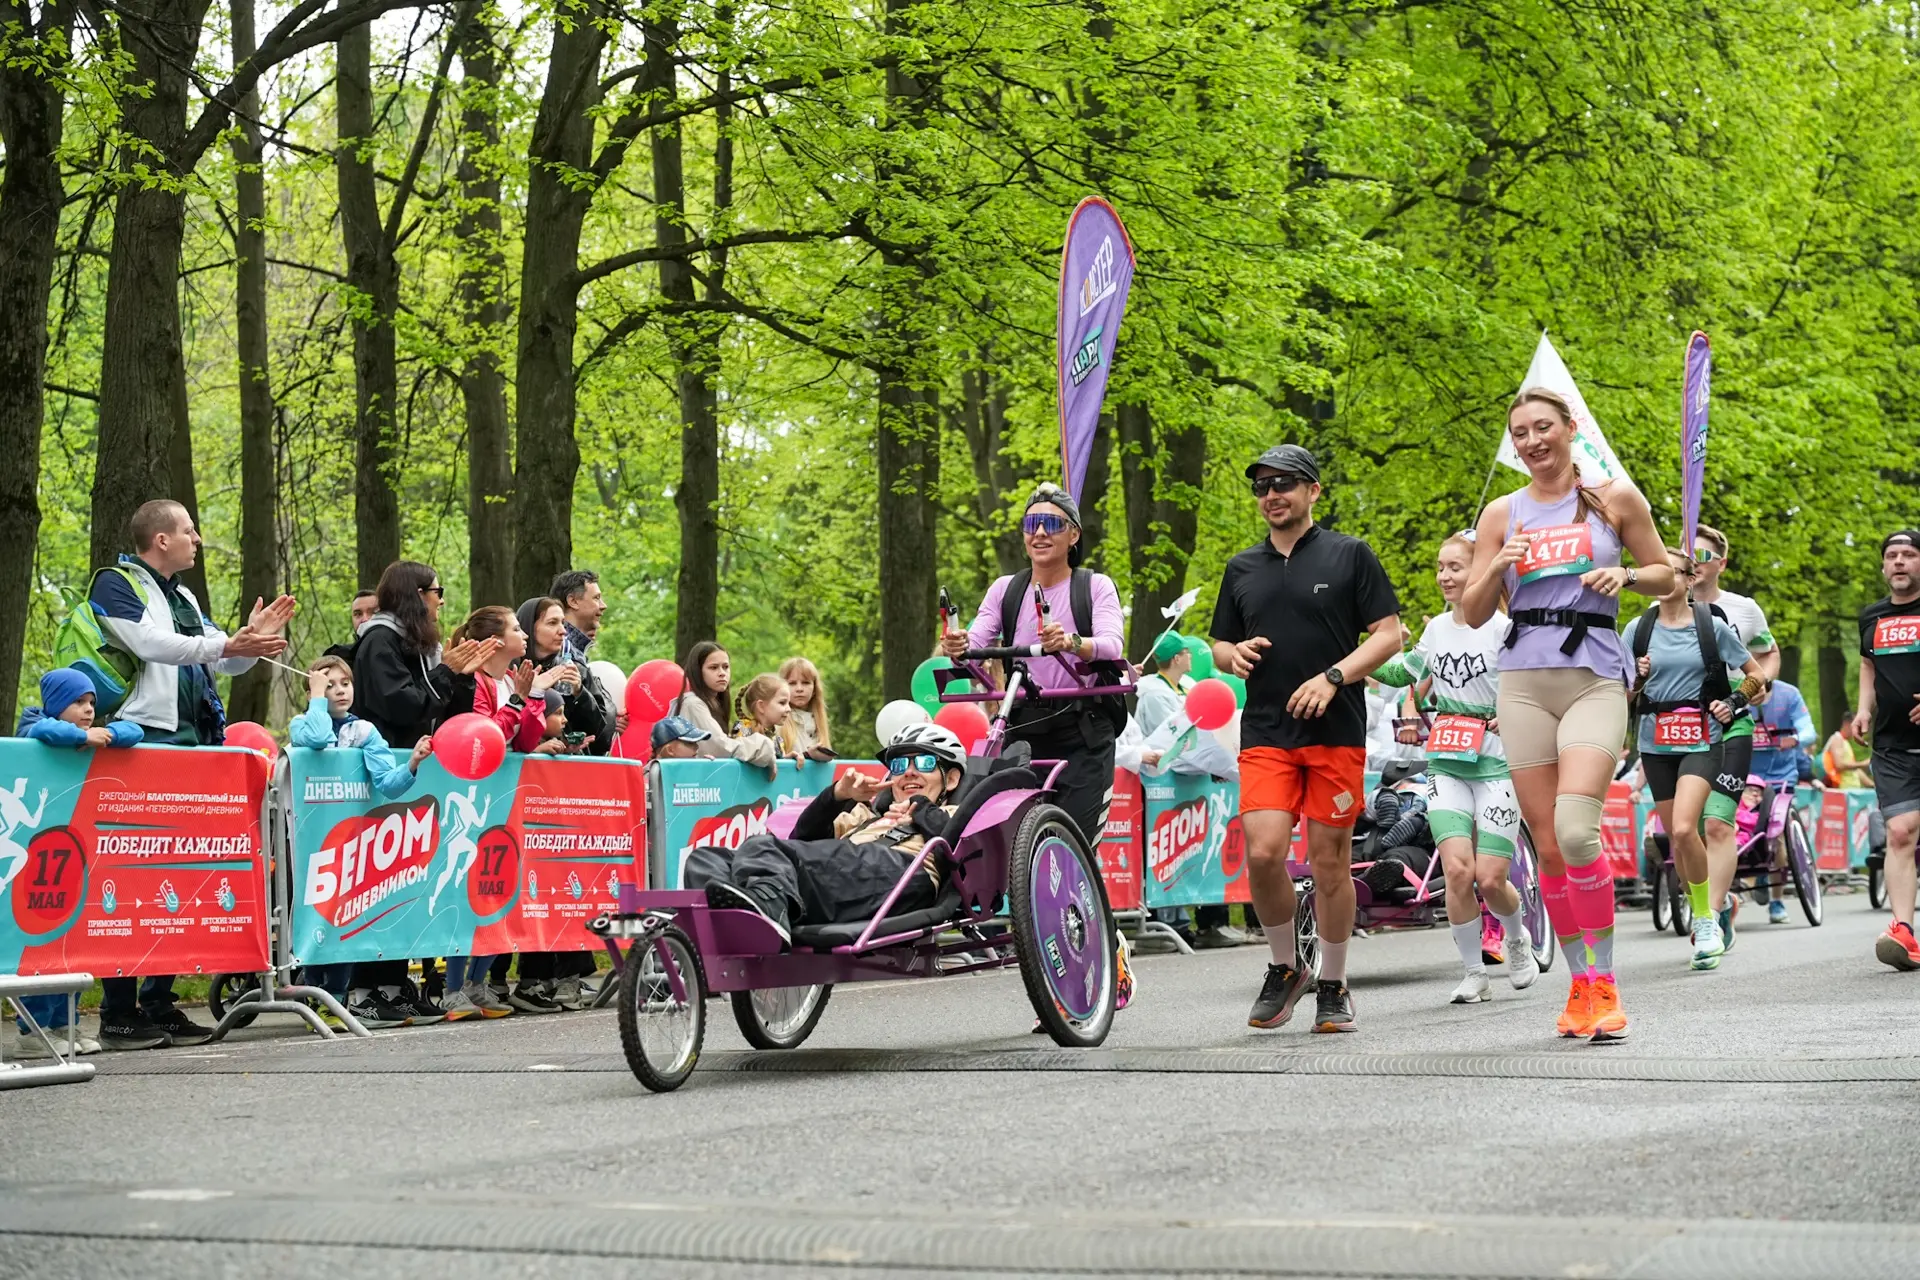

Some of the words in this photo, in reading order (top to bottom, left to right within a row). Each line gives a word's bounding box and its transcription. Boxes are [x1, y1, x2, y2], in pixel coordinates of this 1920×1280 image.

[1524, 538, 1579, 565] 1477
[1880, 626, 1917, 642] 1562
[1433, 730, 1474, 747] 1515
[1661, 725, 1702, 740] 1533
[99, 791, 145, 801] ЕЖЕГОДНЫЙ
[147, 792, 228, 803] БЛАГОТВОРИТЕЛЬНЫЙ
[304, 782, 370, 800] ДНЕВНИК
[672, 787, 721, 804] ДНЕВНИК
[98, 804, 107, 812] ОТ
[108, 804, 144, 813] ИЗДАНИЯ
[524, 834, 577, 853] ПОБЕДИТ
[577, 832, 632, 853] КАЖДЫЙ!
[1147, 800, 1206, 868] БЕГОМ
[95, 836, 173, 858] ПОБЕДИТ
[173, 833, 251, 858] КАЖДЫЙ!
[304, 802, 435, 906] БЕГОМ
[33, 849, 71, 886] 17
[480, 845, 508, 876] 17
[334, 906, 342, 927] С
[341, 863, 428, 925] ДНЕВНИКОМ
[478, 880, 504, 896] МАЯ
[27, 891, 66, 909] МАЯ
